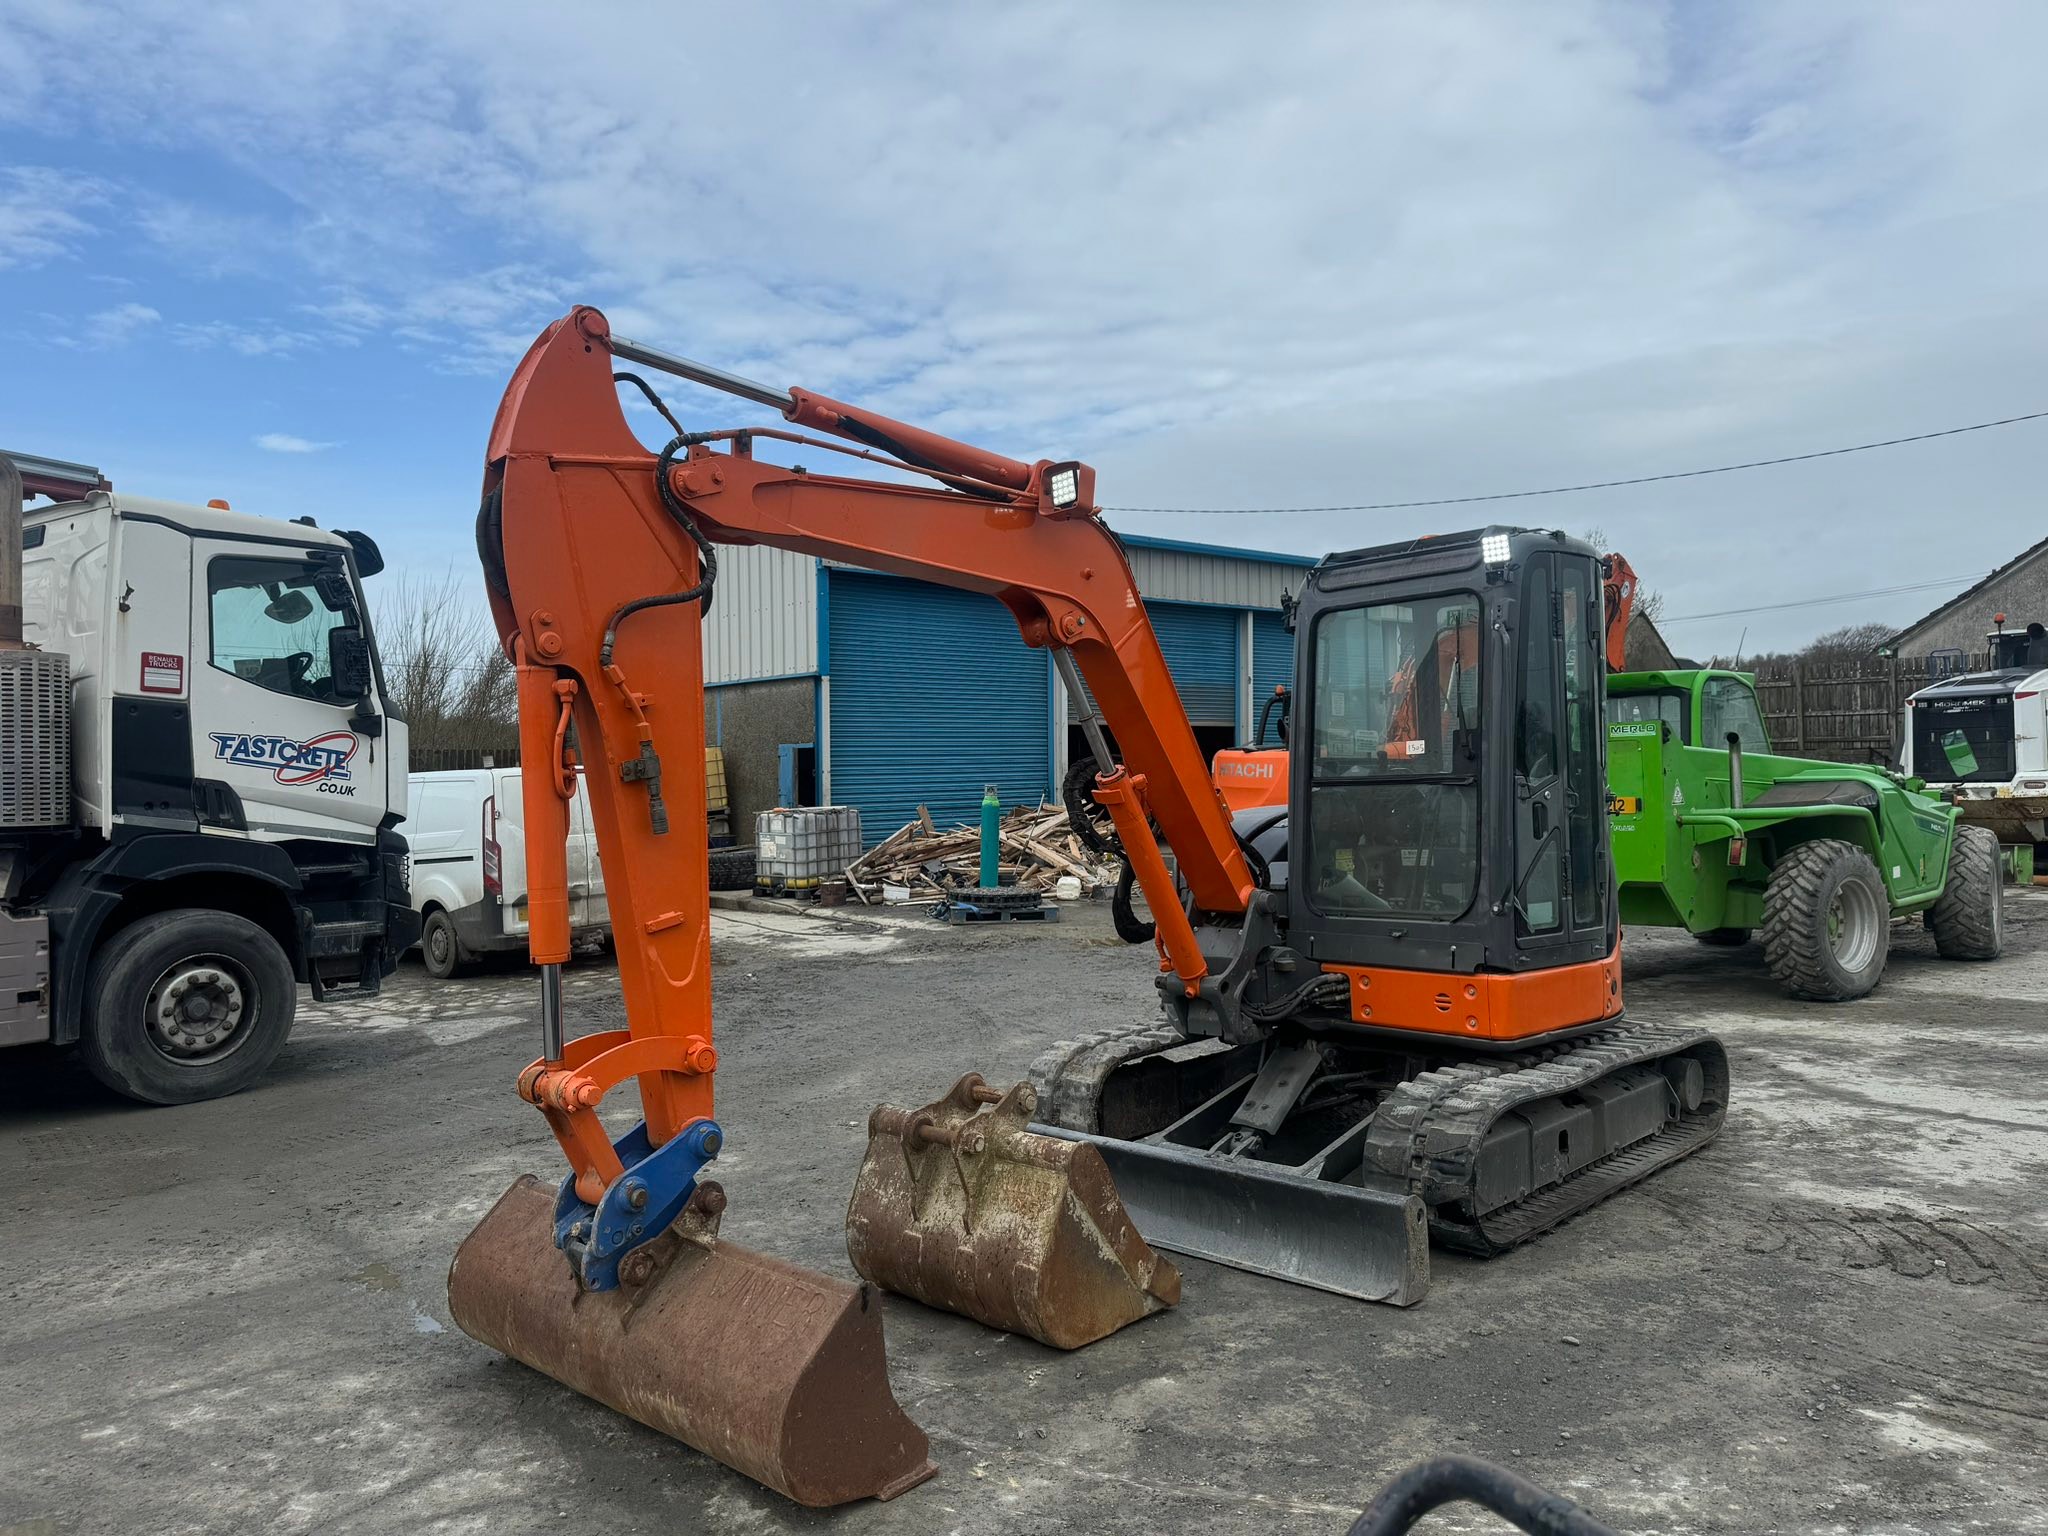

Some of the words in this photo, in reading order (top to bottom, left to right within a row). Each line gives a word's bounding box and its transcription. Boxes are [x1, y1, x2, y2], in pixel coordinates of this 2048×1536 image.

[149, 655, 178, 663] RENAULT
[149, 661, 178, 669] TRUCKS
[1610, 725, 1656, 733] MERLO
[211, 734, 348, 777] FASTCRETE
[316, 782, 357, 797] .CO.UK
